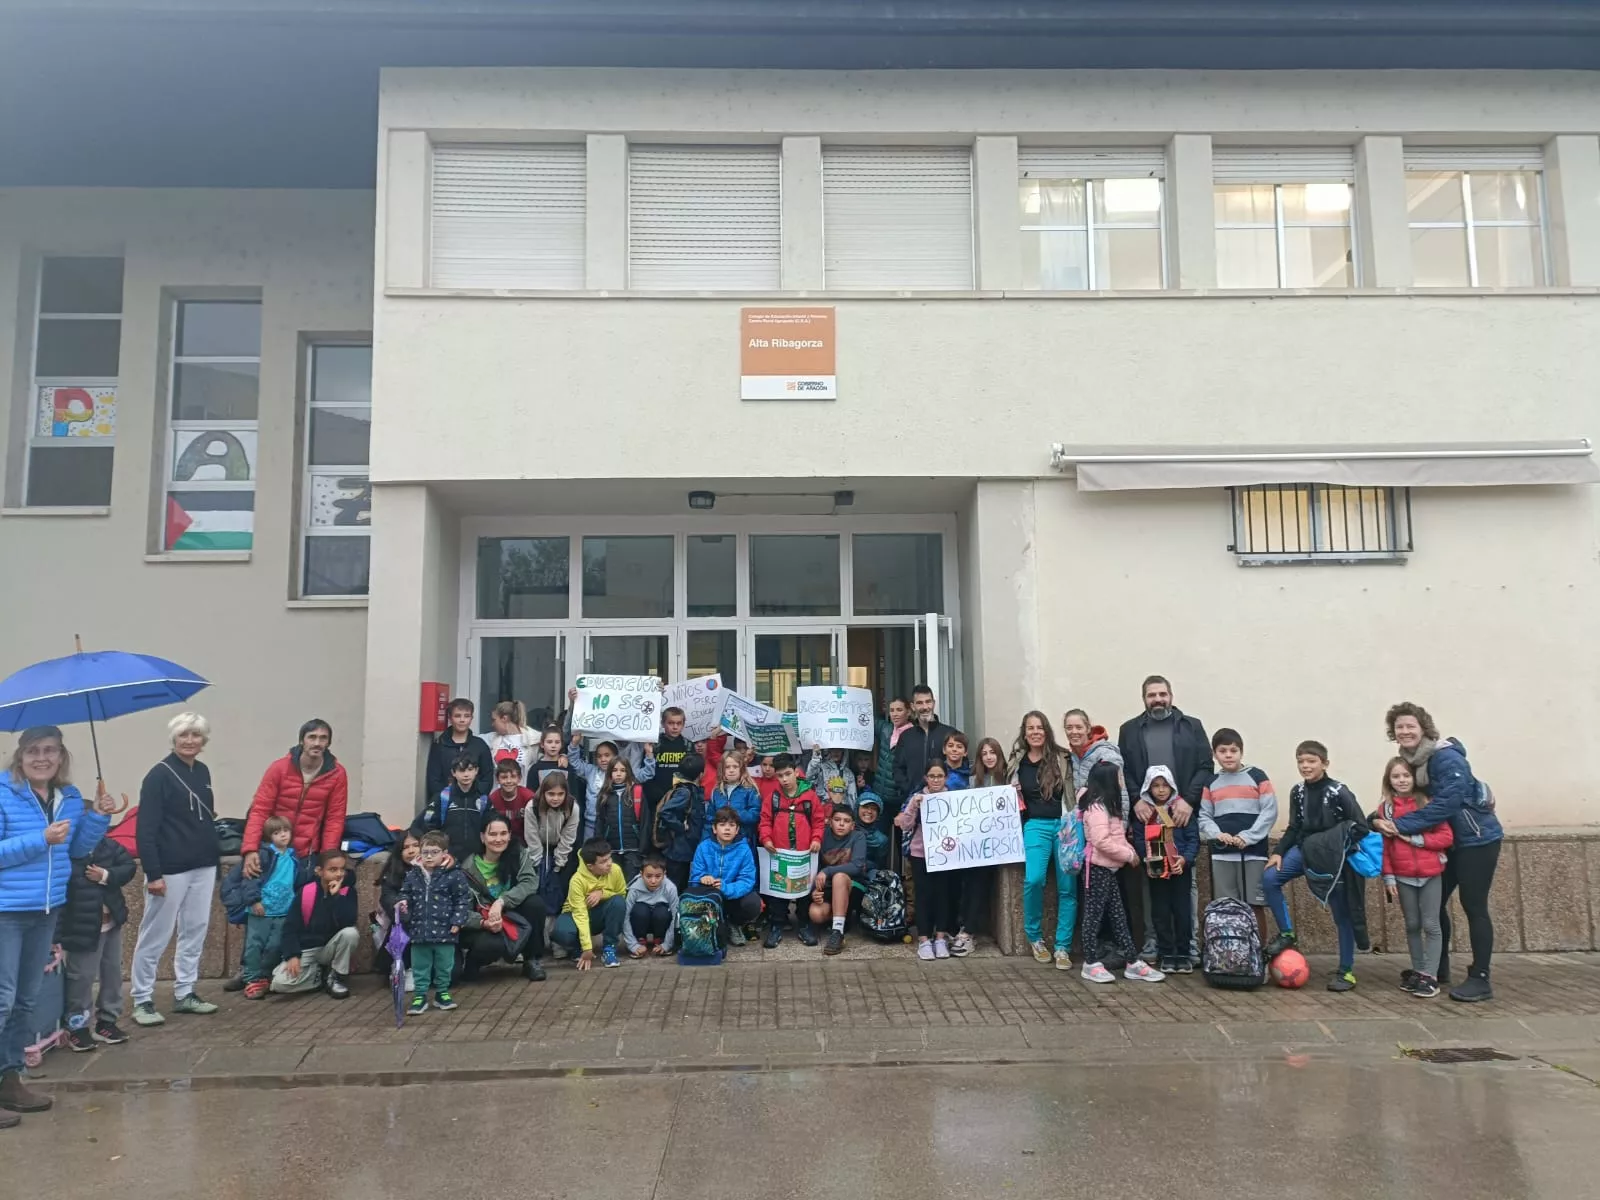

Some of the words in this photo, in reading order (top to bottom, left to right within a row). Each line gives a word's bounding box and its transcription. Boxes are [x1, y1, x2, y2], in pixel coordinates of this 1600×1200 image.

[749, 339, 769, 347] Alta
[772, 339, 823, 350] Ribagorza
[592, 694, 610, 710] NO
[619, 694, 643, 709] SE
[800, 728, 870, 743] FUTURO
[930, 825, 948, 841] NO
[957, 817, 974, 835] ES
[980, 814, 1020, 833] GASTO
[927, 844, 948, 866] ES
